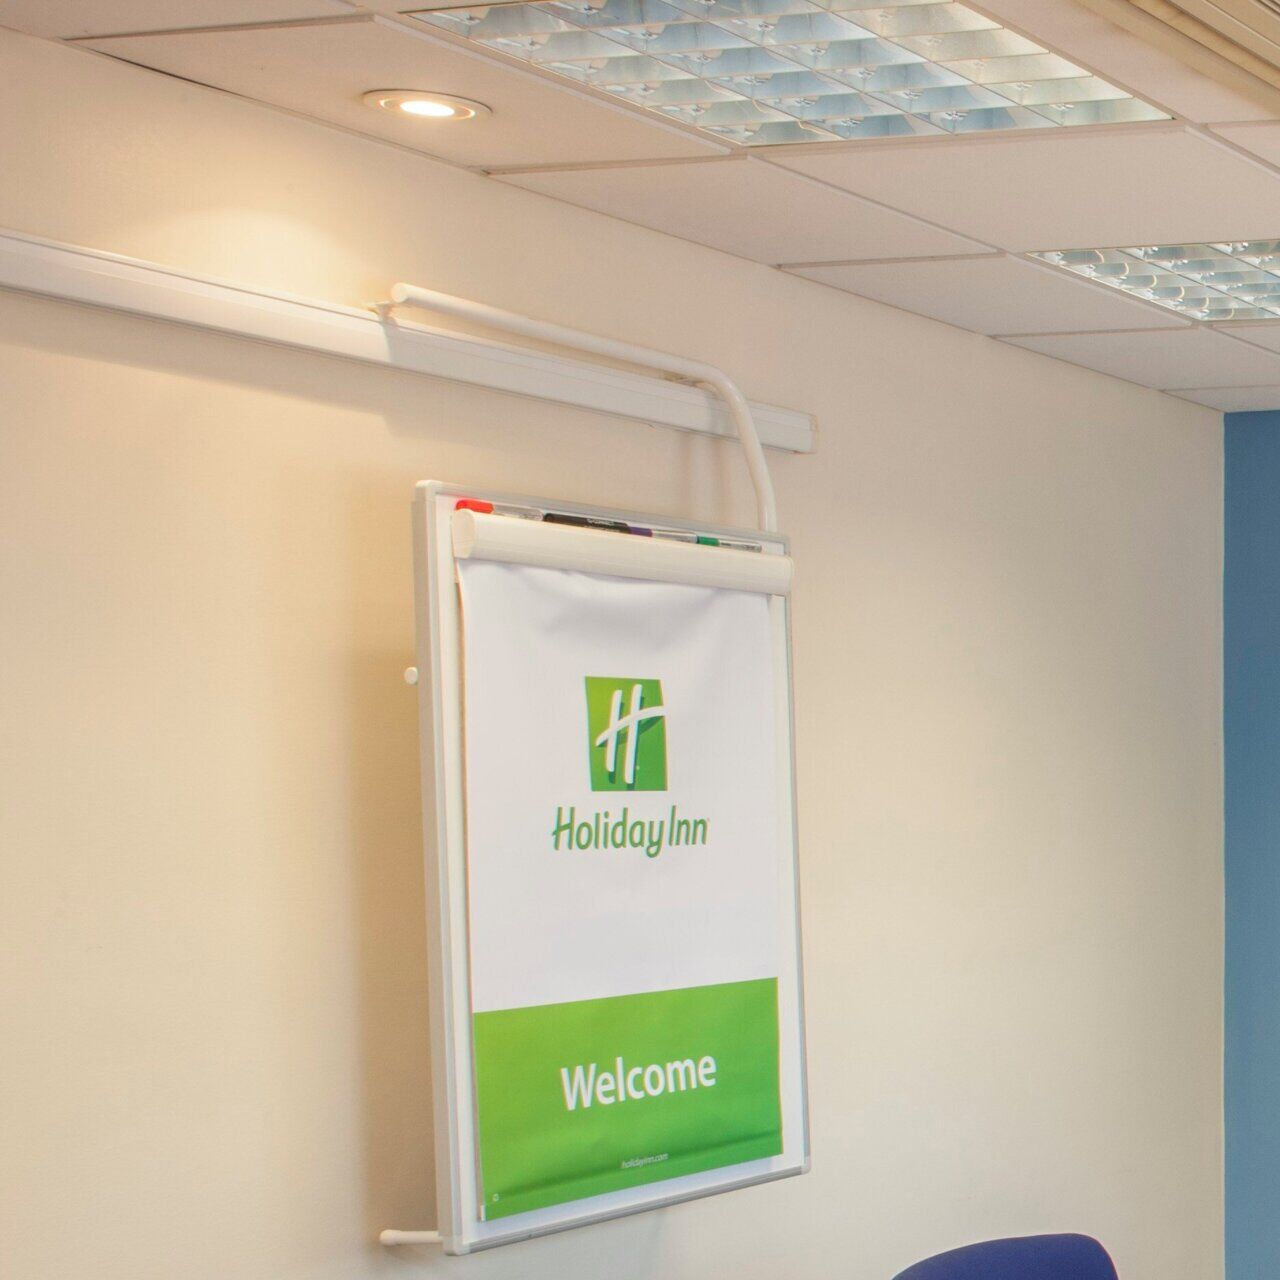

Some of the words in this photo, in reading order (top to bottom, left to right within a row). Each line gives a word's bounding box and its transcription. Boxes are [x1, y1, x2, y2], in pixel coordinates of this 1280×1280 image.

[552, 805, 665, 858] Holiday
[668, 804, 709, 846] Inn
[560, 1055, 717, 1111] Welcome
